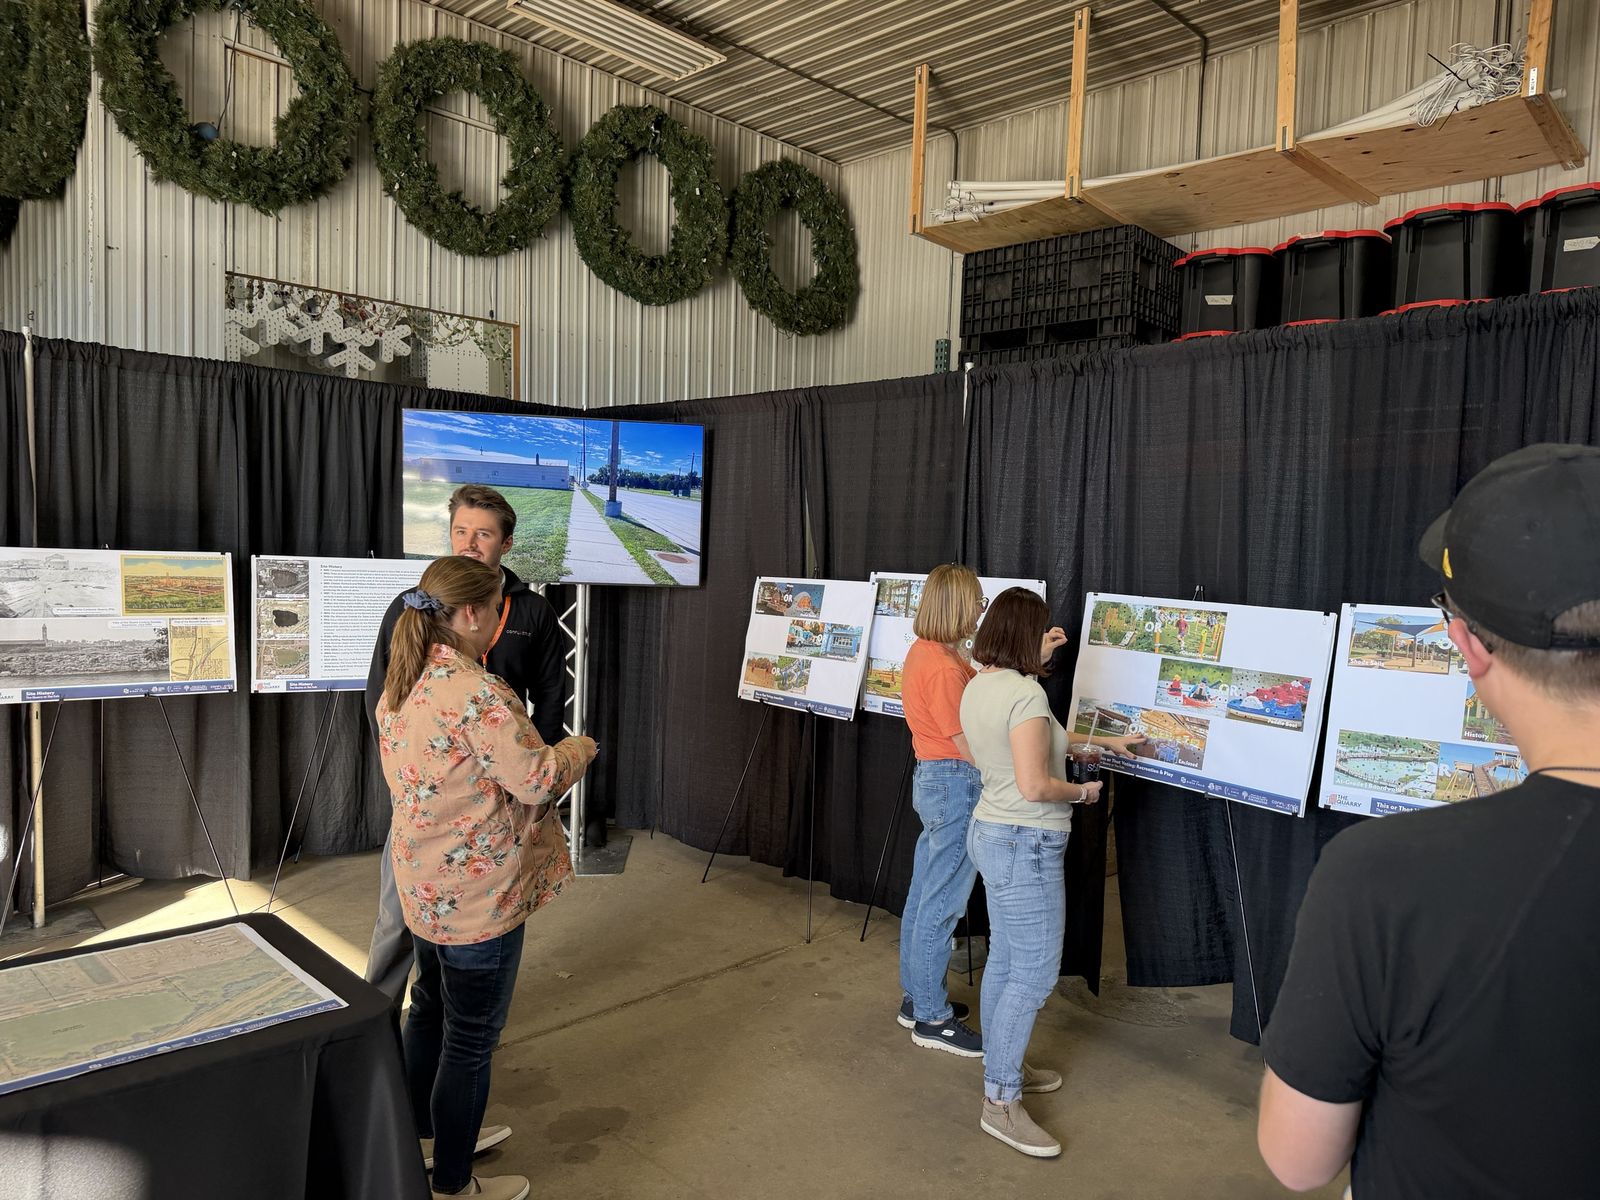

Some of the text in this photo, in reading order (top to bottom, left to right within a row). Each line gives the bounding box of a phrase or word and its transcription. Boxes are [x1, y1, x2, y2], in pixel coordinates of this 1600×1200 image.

[783, 594, 793, 603] OR
[1144, 621, 1162, 634] OR
[771, 666, 781, 676] OR
[1219, 684, 1239, 697] OR
[1464, 731, 1489, 740] History
[1178, 758, 1199, 768] Enclosed
[1136, 764, 1159, 774] Recreation
[1163, 770, 1174, 778] Play
[1376, 801, 1390, 809] This
